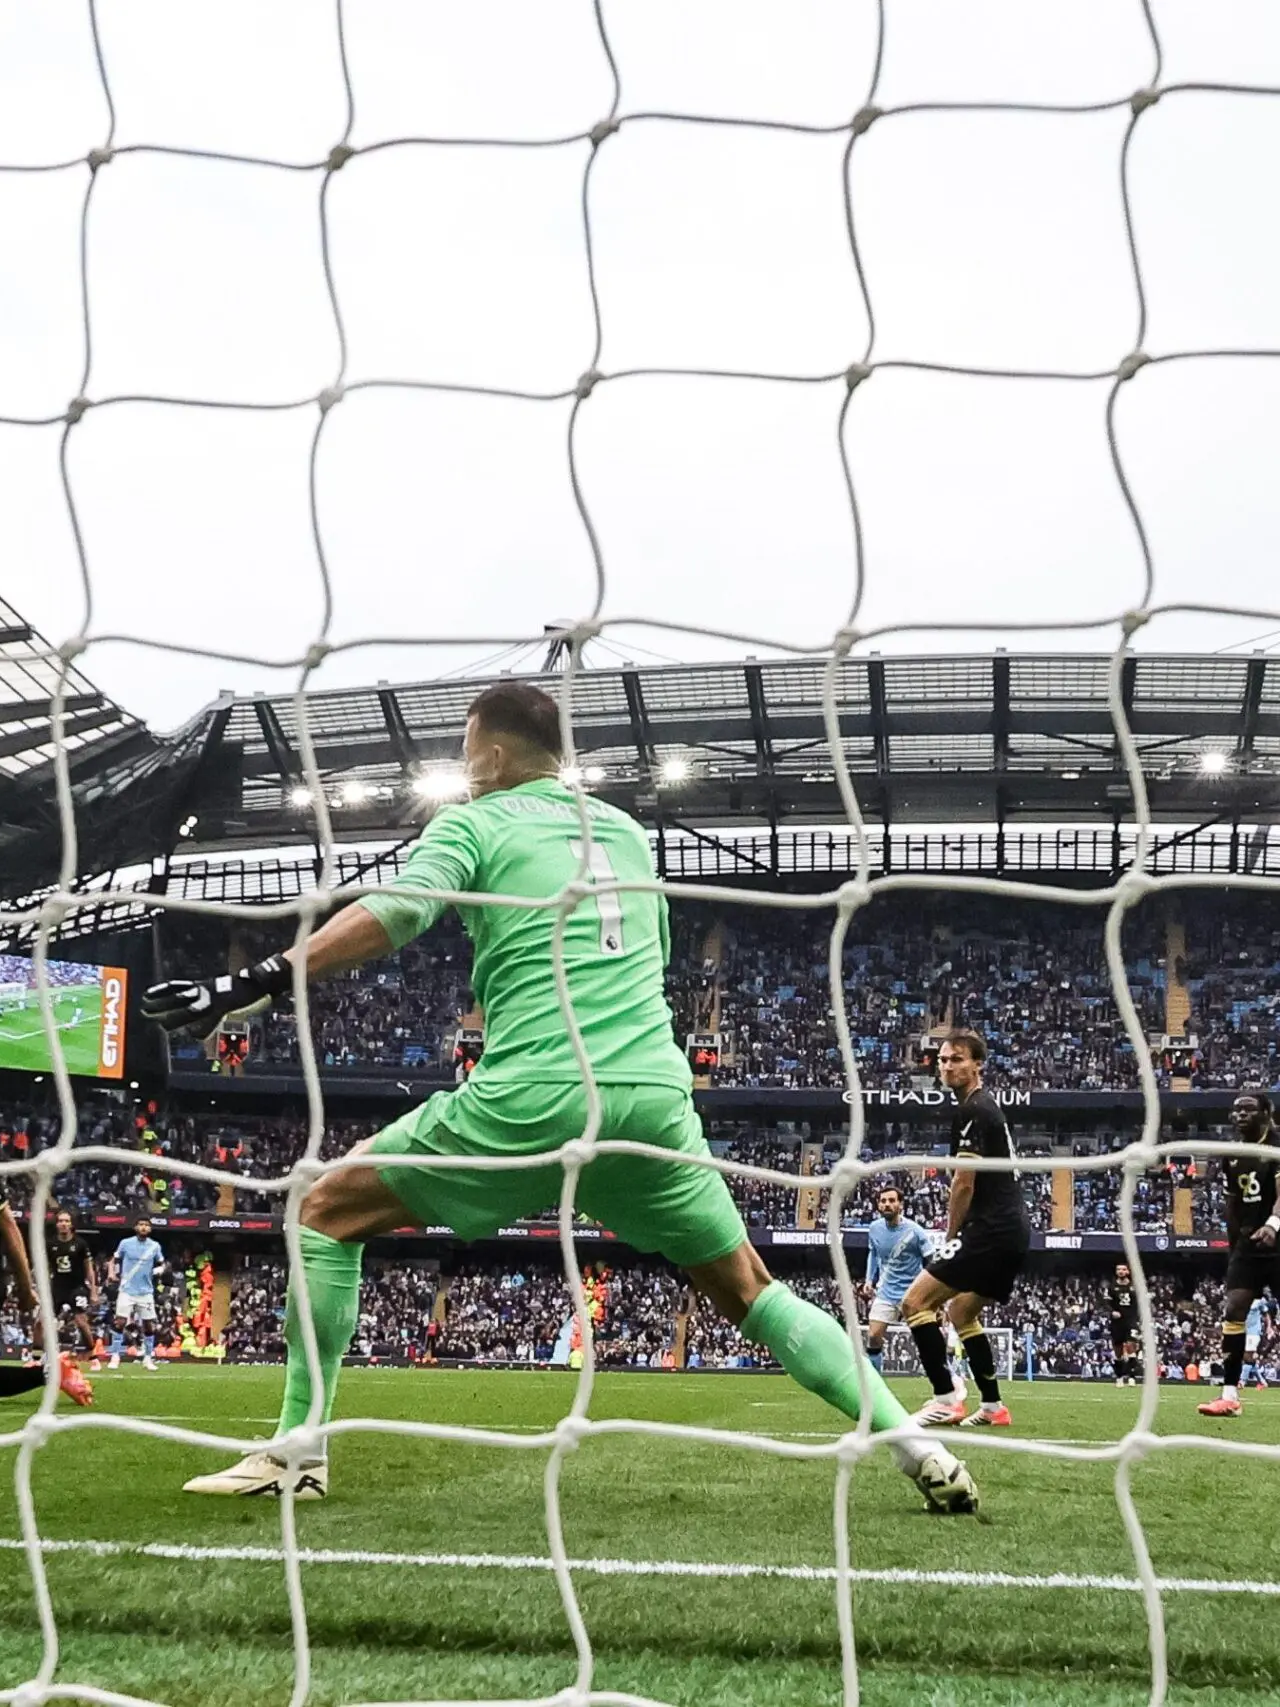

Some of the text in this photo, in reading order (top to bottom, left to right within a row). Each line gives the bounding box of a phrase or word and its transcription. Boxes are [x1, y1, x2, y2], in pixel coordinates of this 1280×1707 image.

[567, 838, 625, 955] 1
[102, 978, 121, 1067] ETIHAD
[842, 1090, 945, 1105] ETIHAD
[772, 1231, 825, 1245] MANCHESTER
[1045, 1235, 1083, 1249] BURNLEY
